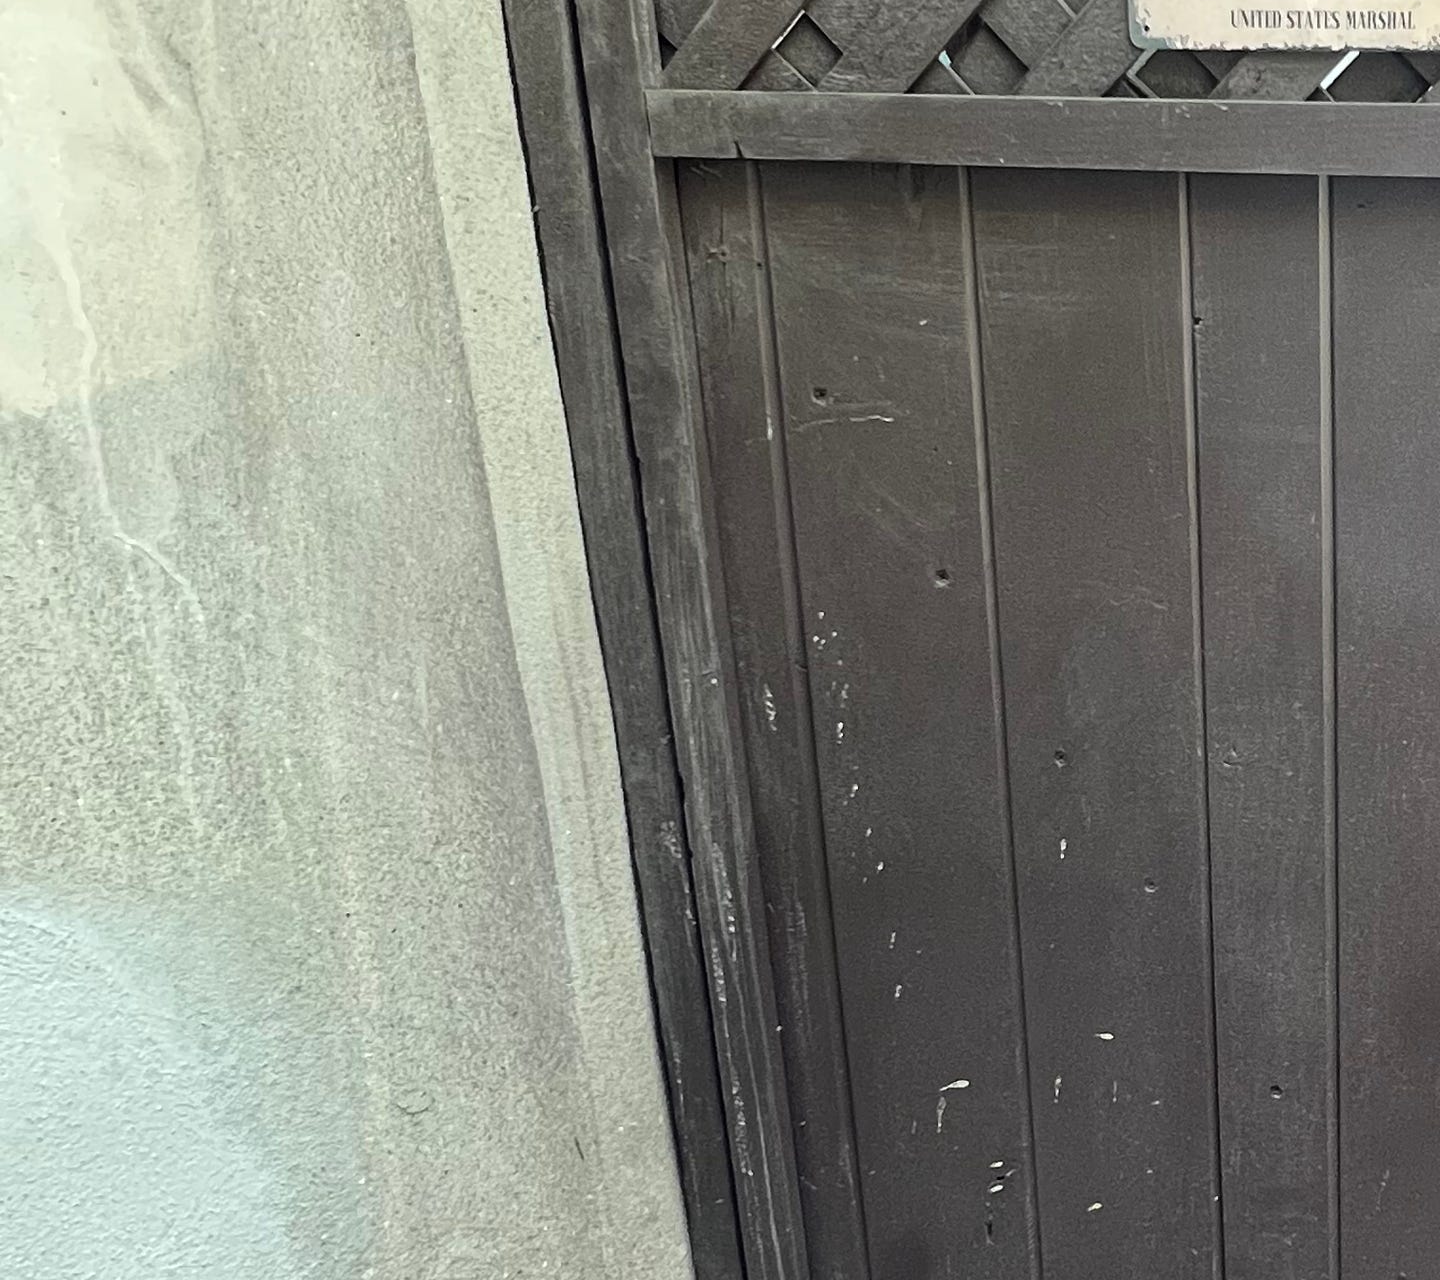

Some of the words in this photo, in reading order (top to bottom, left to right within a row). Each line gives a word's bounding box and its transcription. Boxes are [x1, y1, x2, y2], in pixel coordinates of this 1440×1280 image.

[1230, 10, 1281, 30] UNITED
[1286, 10, 1340, 30] STATES
[1345, 9, 1416, 30] MARSHAL
